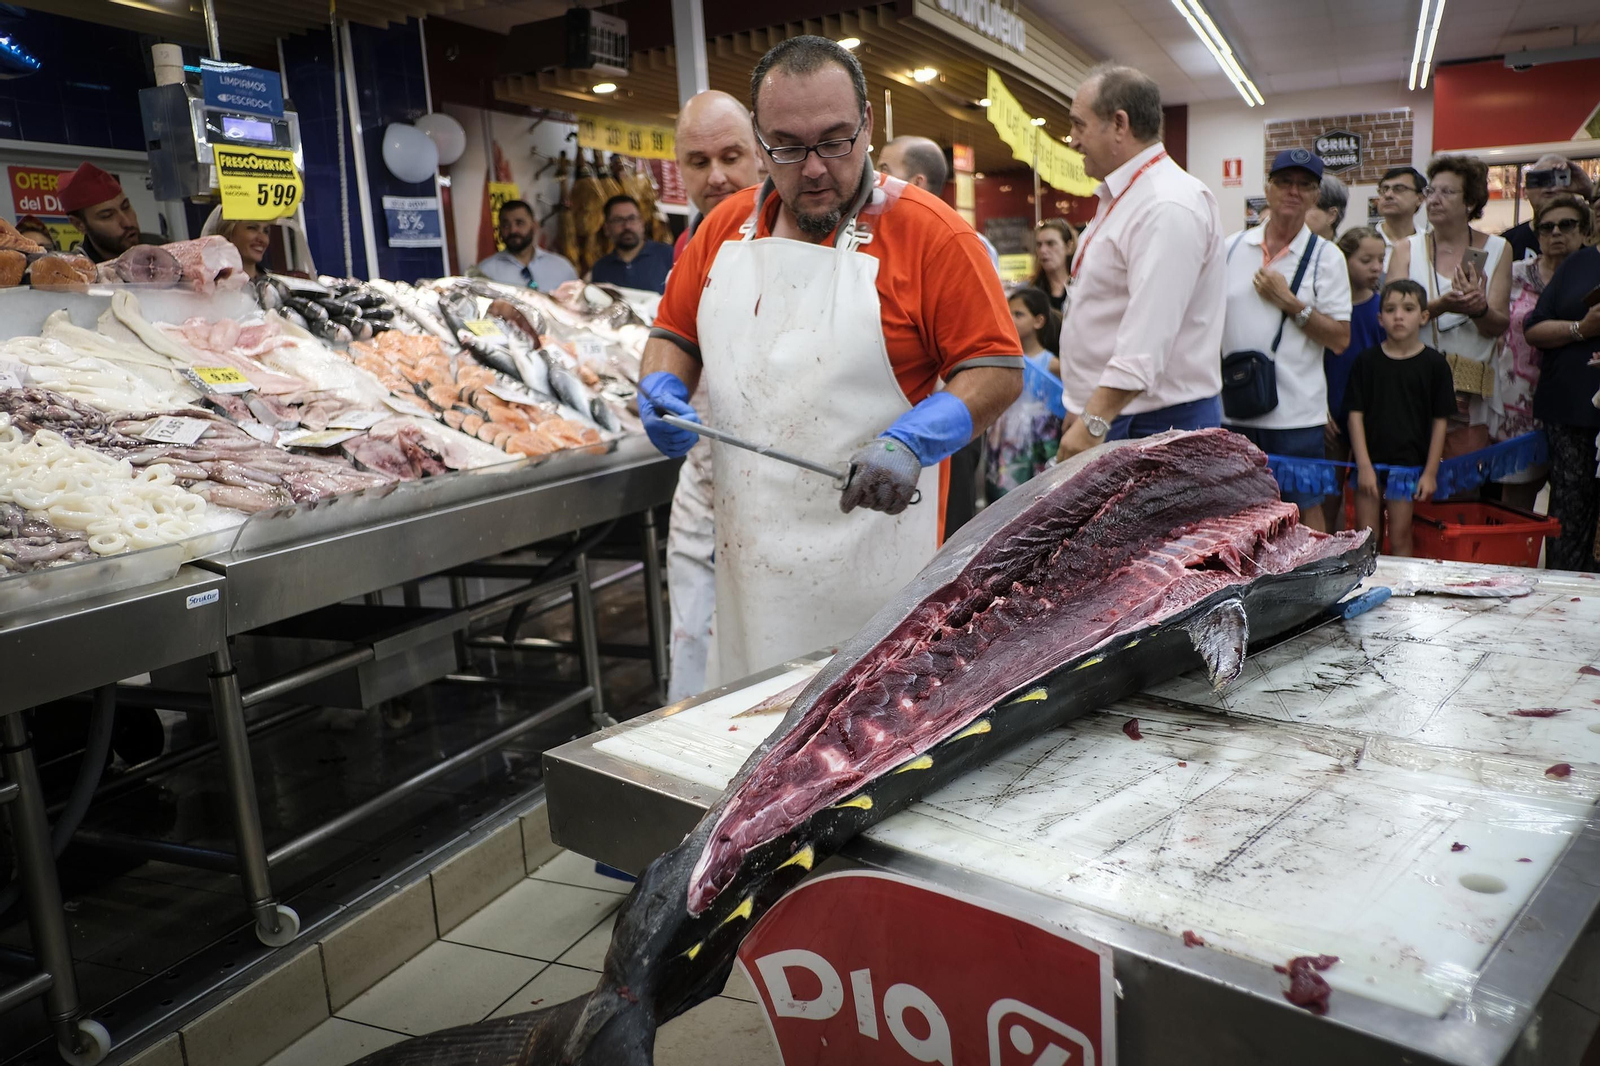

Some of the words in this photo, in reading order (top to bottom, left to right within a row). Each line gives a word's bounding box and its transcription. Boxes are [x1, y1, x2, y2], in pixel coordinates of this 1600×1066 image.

[219, 75, 266, 92] LIMPIAMOS
[225, 94, 265, 109] PESCADO
[1316, 136, 1358, 152] GRILL
[15, 171, 58, 191] OFER
[19, 195, 41, 211] del
[44, 194, 65, 212] DI
